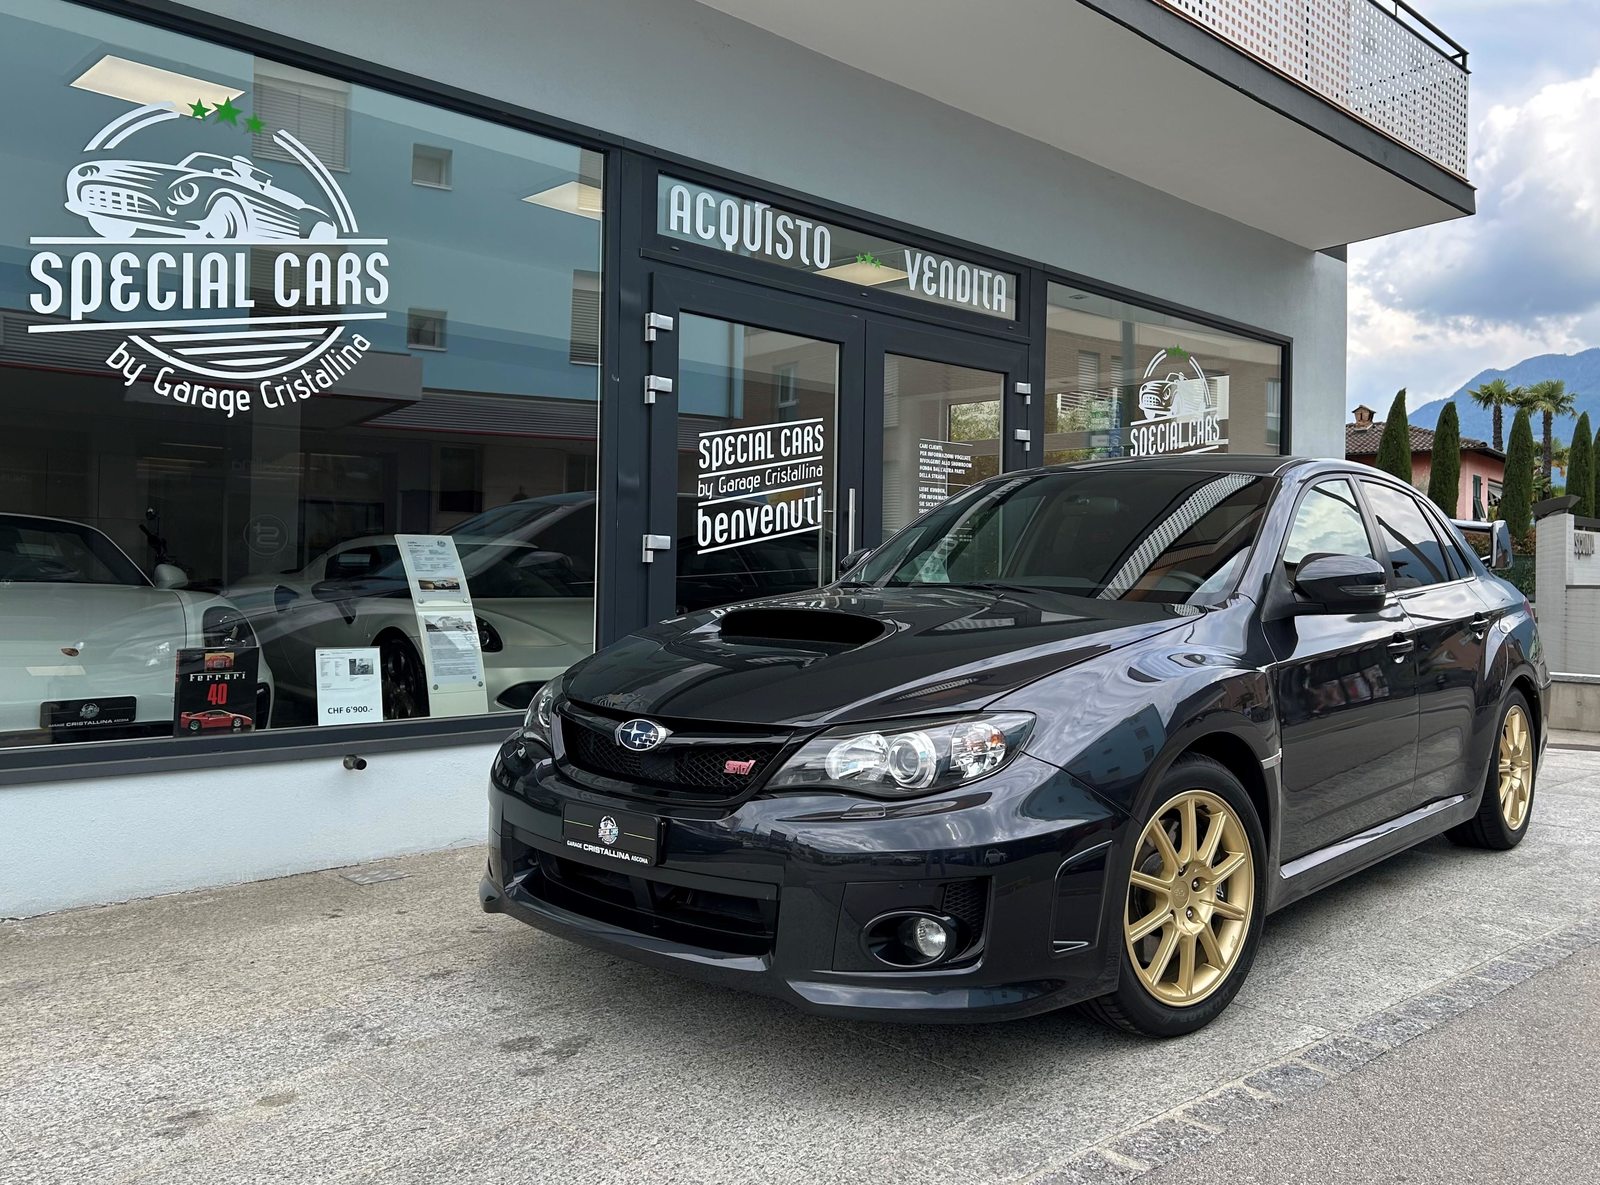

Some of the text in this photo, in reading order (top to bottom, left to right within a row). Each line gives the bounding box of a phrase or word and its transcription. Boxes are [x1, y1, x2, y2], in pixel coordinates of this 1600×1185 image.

[669, 184, 1007, 313] ACQUISTO VENDITA
[274, 251, 390, 308] CARS
[105, 333, 371, 418] by Garage Cristallina
[780, 424, 824, 457] CARS
[1189, 414, 1220, 447] CARS
[697, 463, 823, 499] by Garage Cristallina
[697, 487, 823, 547] benvenuti
[189, 671, 246, 682] Ferrari
[207, 683, 228, 705] 40
[327, 705, 373, 714] CHF 6'900.-
[66, 719, 113, 727] CRISTALLINA
[566, 840, 583, 849] GARAGE
[583, 843, 631, 861] CRISTALLINA
